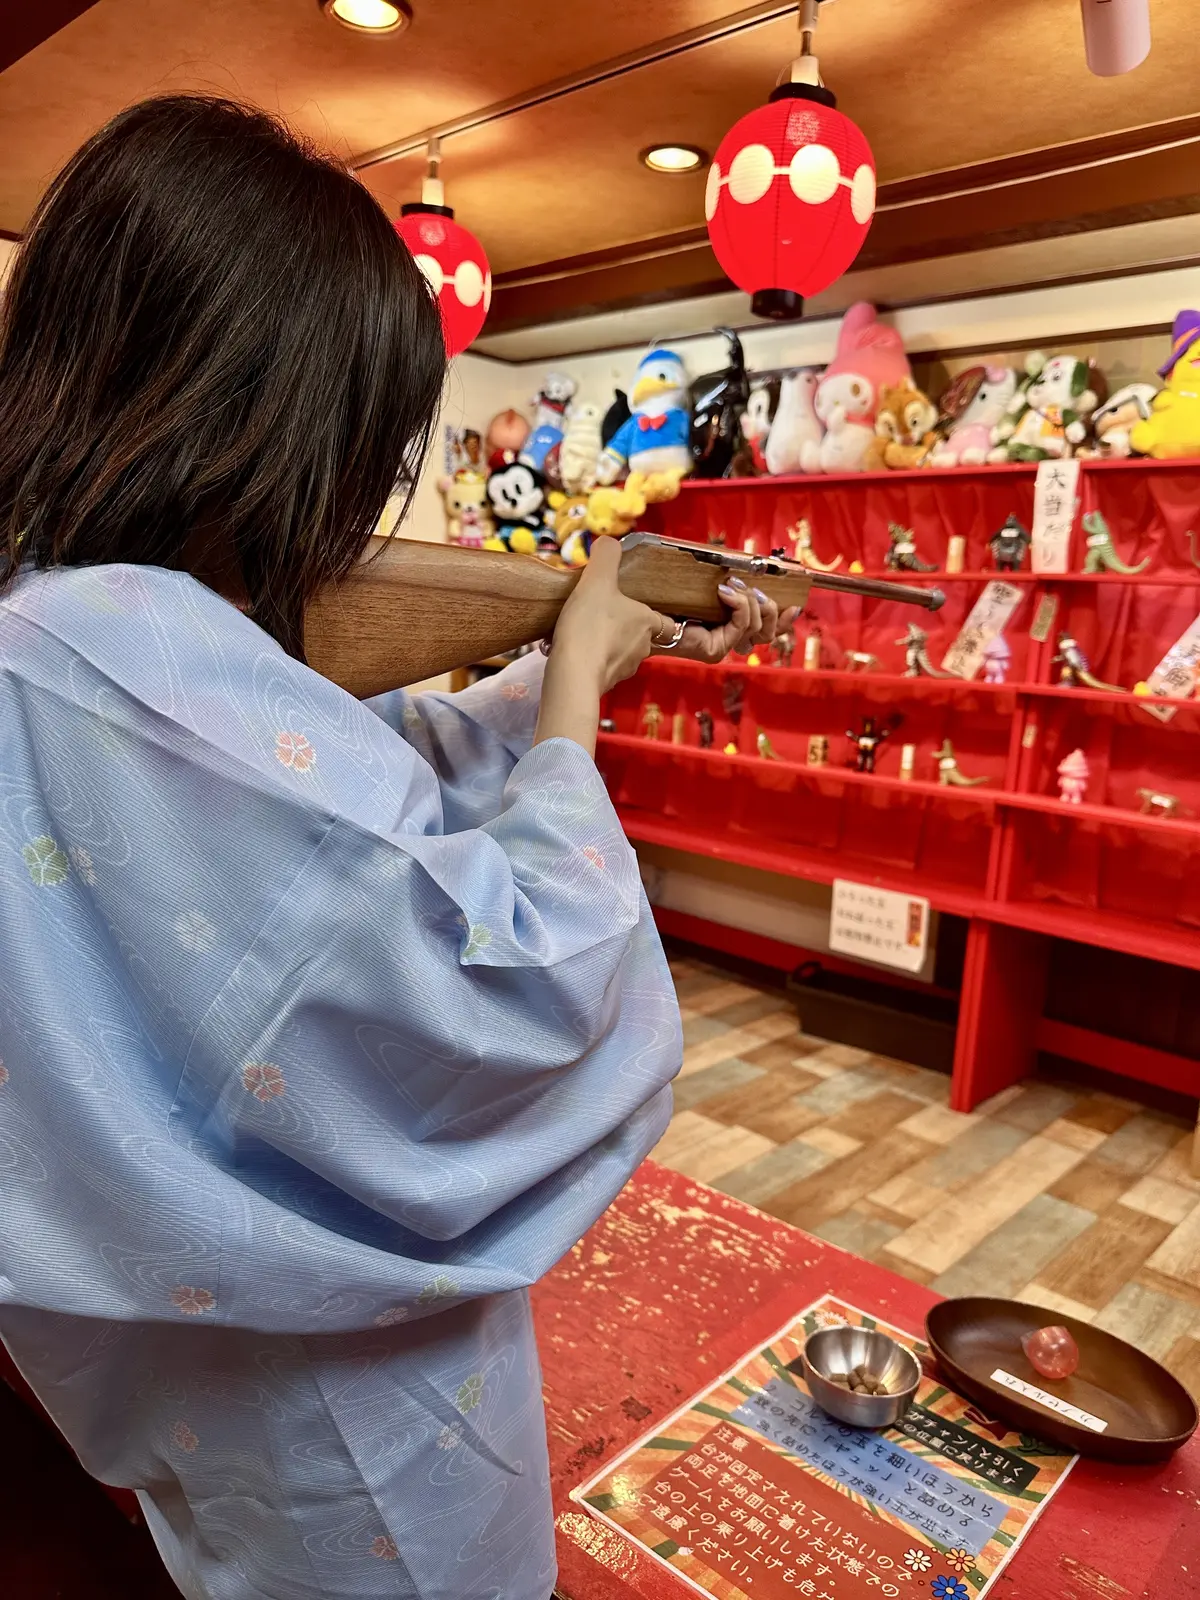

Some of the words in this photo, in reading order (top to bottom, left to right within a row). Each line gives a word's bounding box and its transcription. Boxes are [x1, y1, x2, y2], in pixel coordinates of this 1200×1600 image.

[713, 1426, 749, 1453] 注意
[636, 1493, 754, 1584] ご遠慮ください。
[668, 1465, 837, 1587] ゲームをお願いします。
[684, 1453, 900, 1597] 両足を地面に着けた状態での
[701, 1442, 914, 1582] 台が固定さえれていないので
